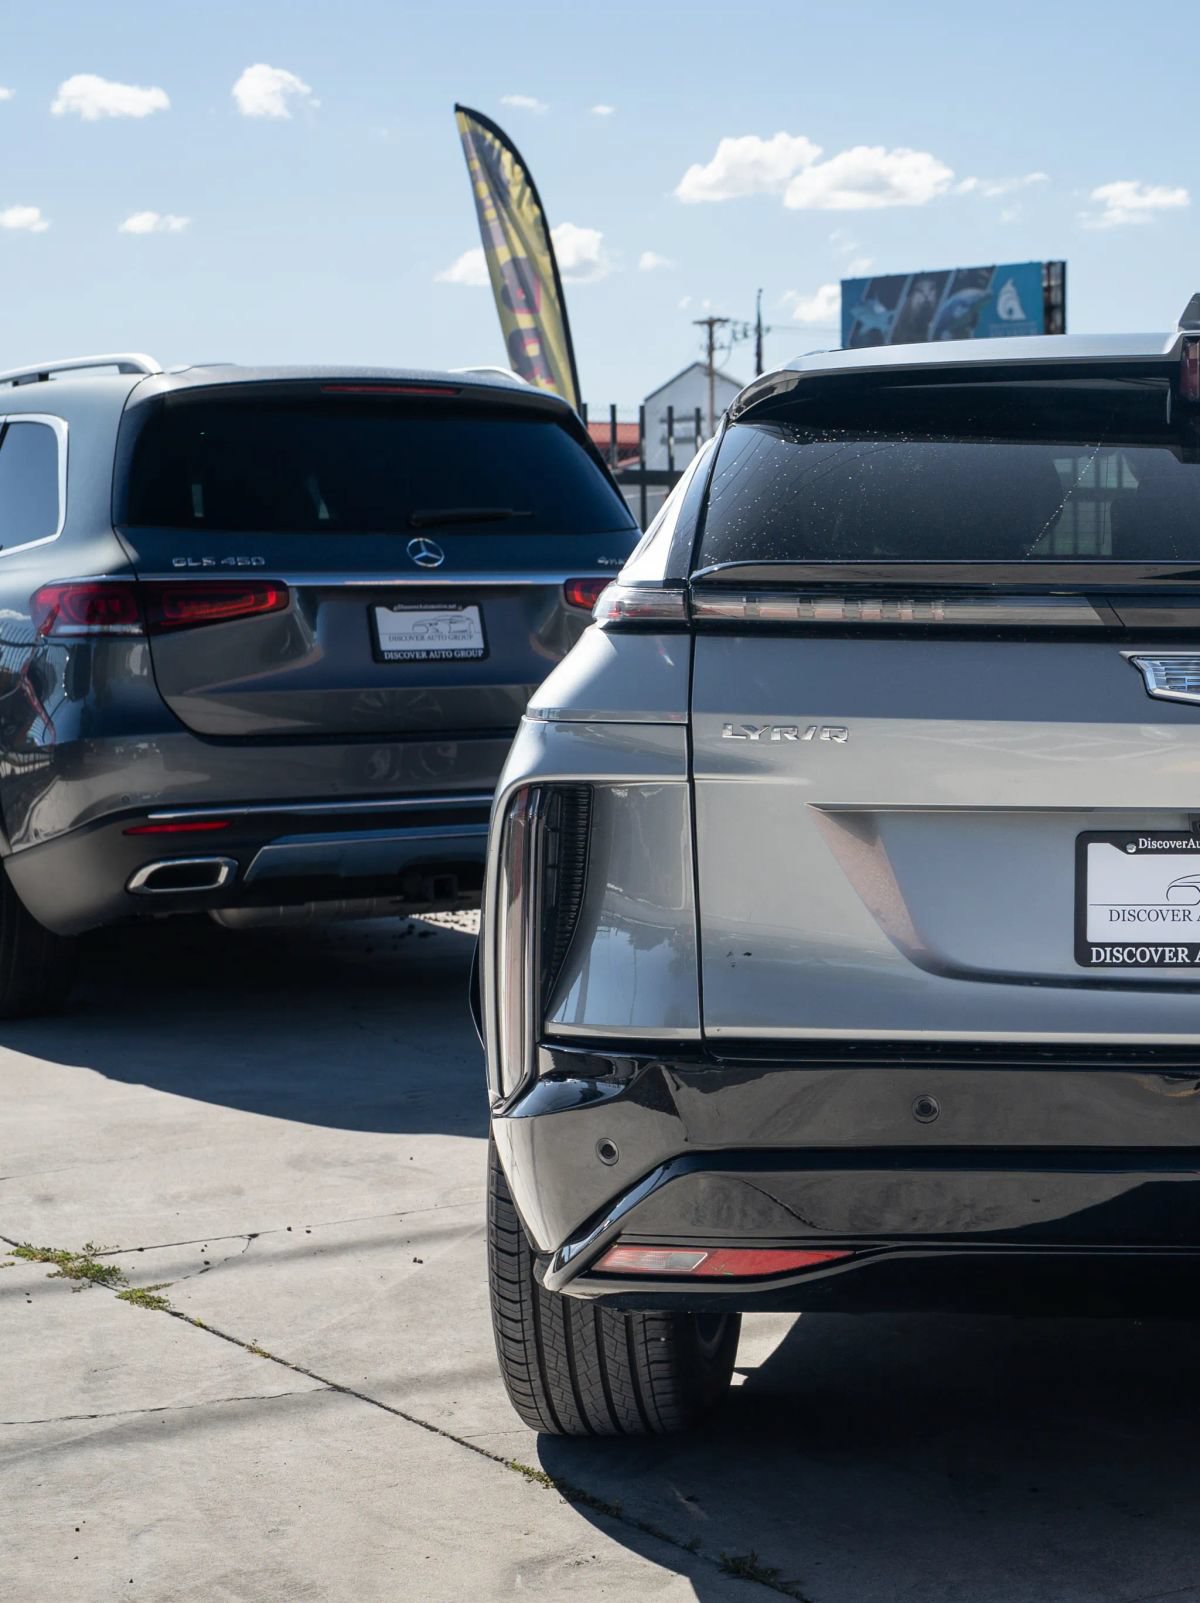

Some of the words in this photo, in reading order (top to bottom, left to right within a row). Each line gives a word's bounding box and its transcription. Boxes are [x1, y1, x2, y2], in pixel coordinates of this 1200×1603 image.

[172, 557, 216, 567] GLS
[221, 556, 265, 566] 450
[385, 651, 427, 659] DISCOVER
[429, 650, 452, 658] AUTO
[454, 650, 483, 658] GROUP
[1108, 909, 1192, 922] DISCOVER
[1091, 947, 1191, 963] DISCOVER
